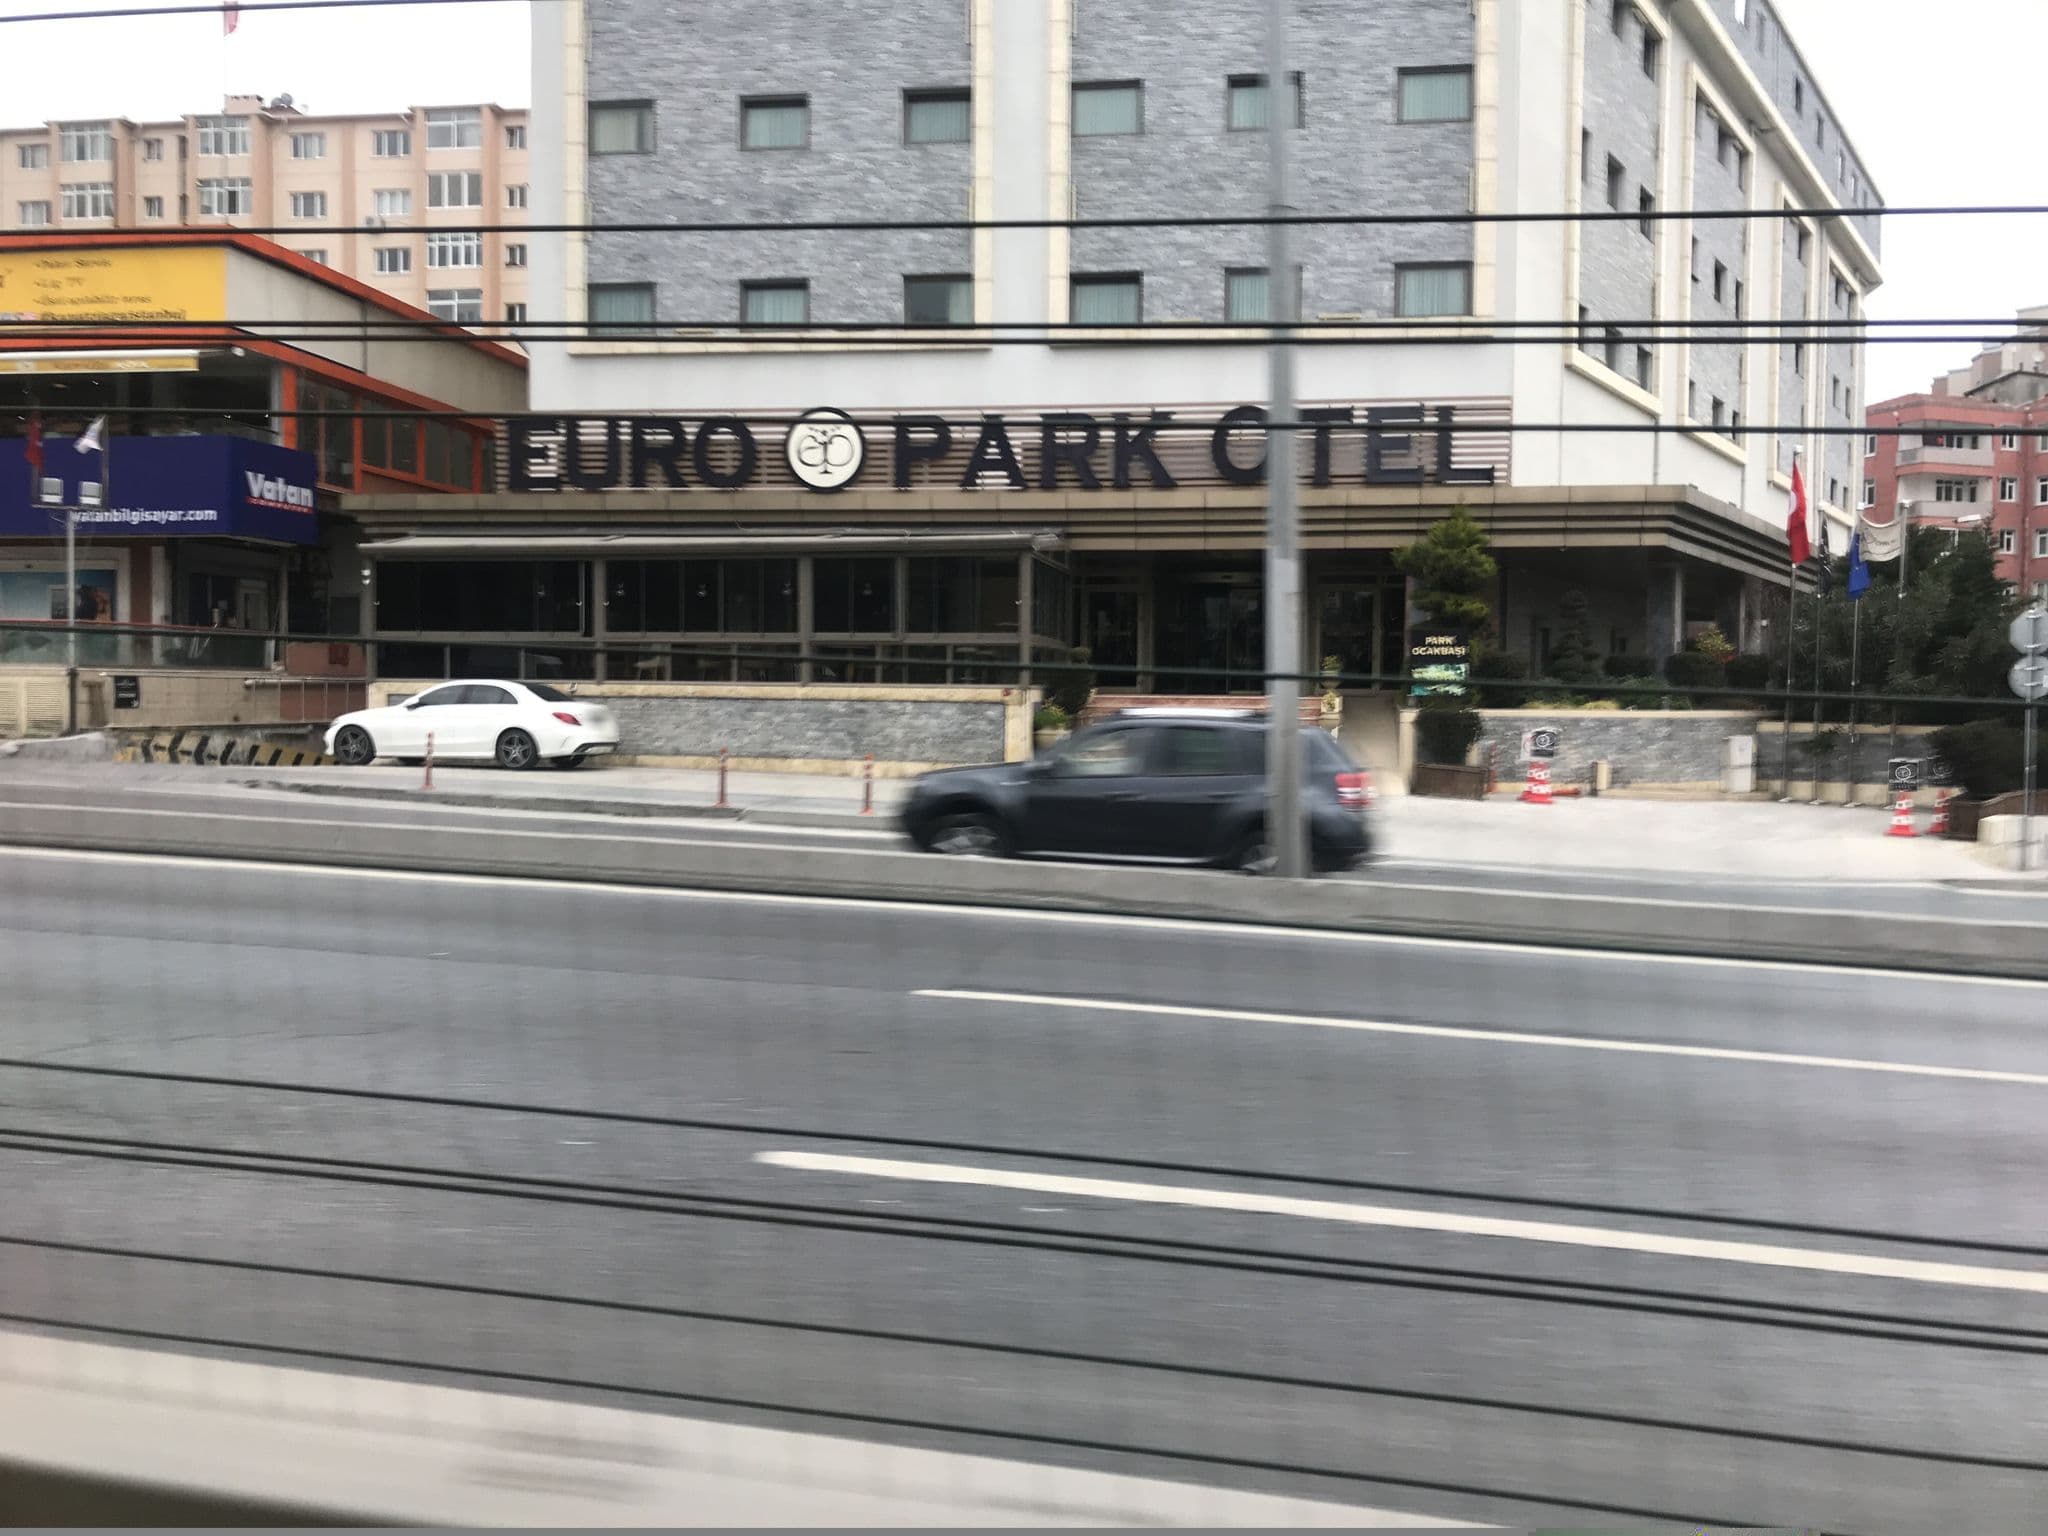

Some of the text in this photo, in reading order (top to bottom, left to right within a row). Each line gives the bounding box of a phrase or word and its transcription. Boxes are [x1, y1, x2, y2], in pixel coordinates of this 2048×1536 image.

[508, 404, 1494, 492] EURO PARK OTEL
[245, 470, 313, 508] Vatan
[1425, 635, 1457, 645] PARK
